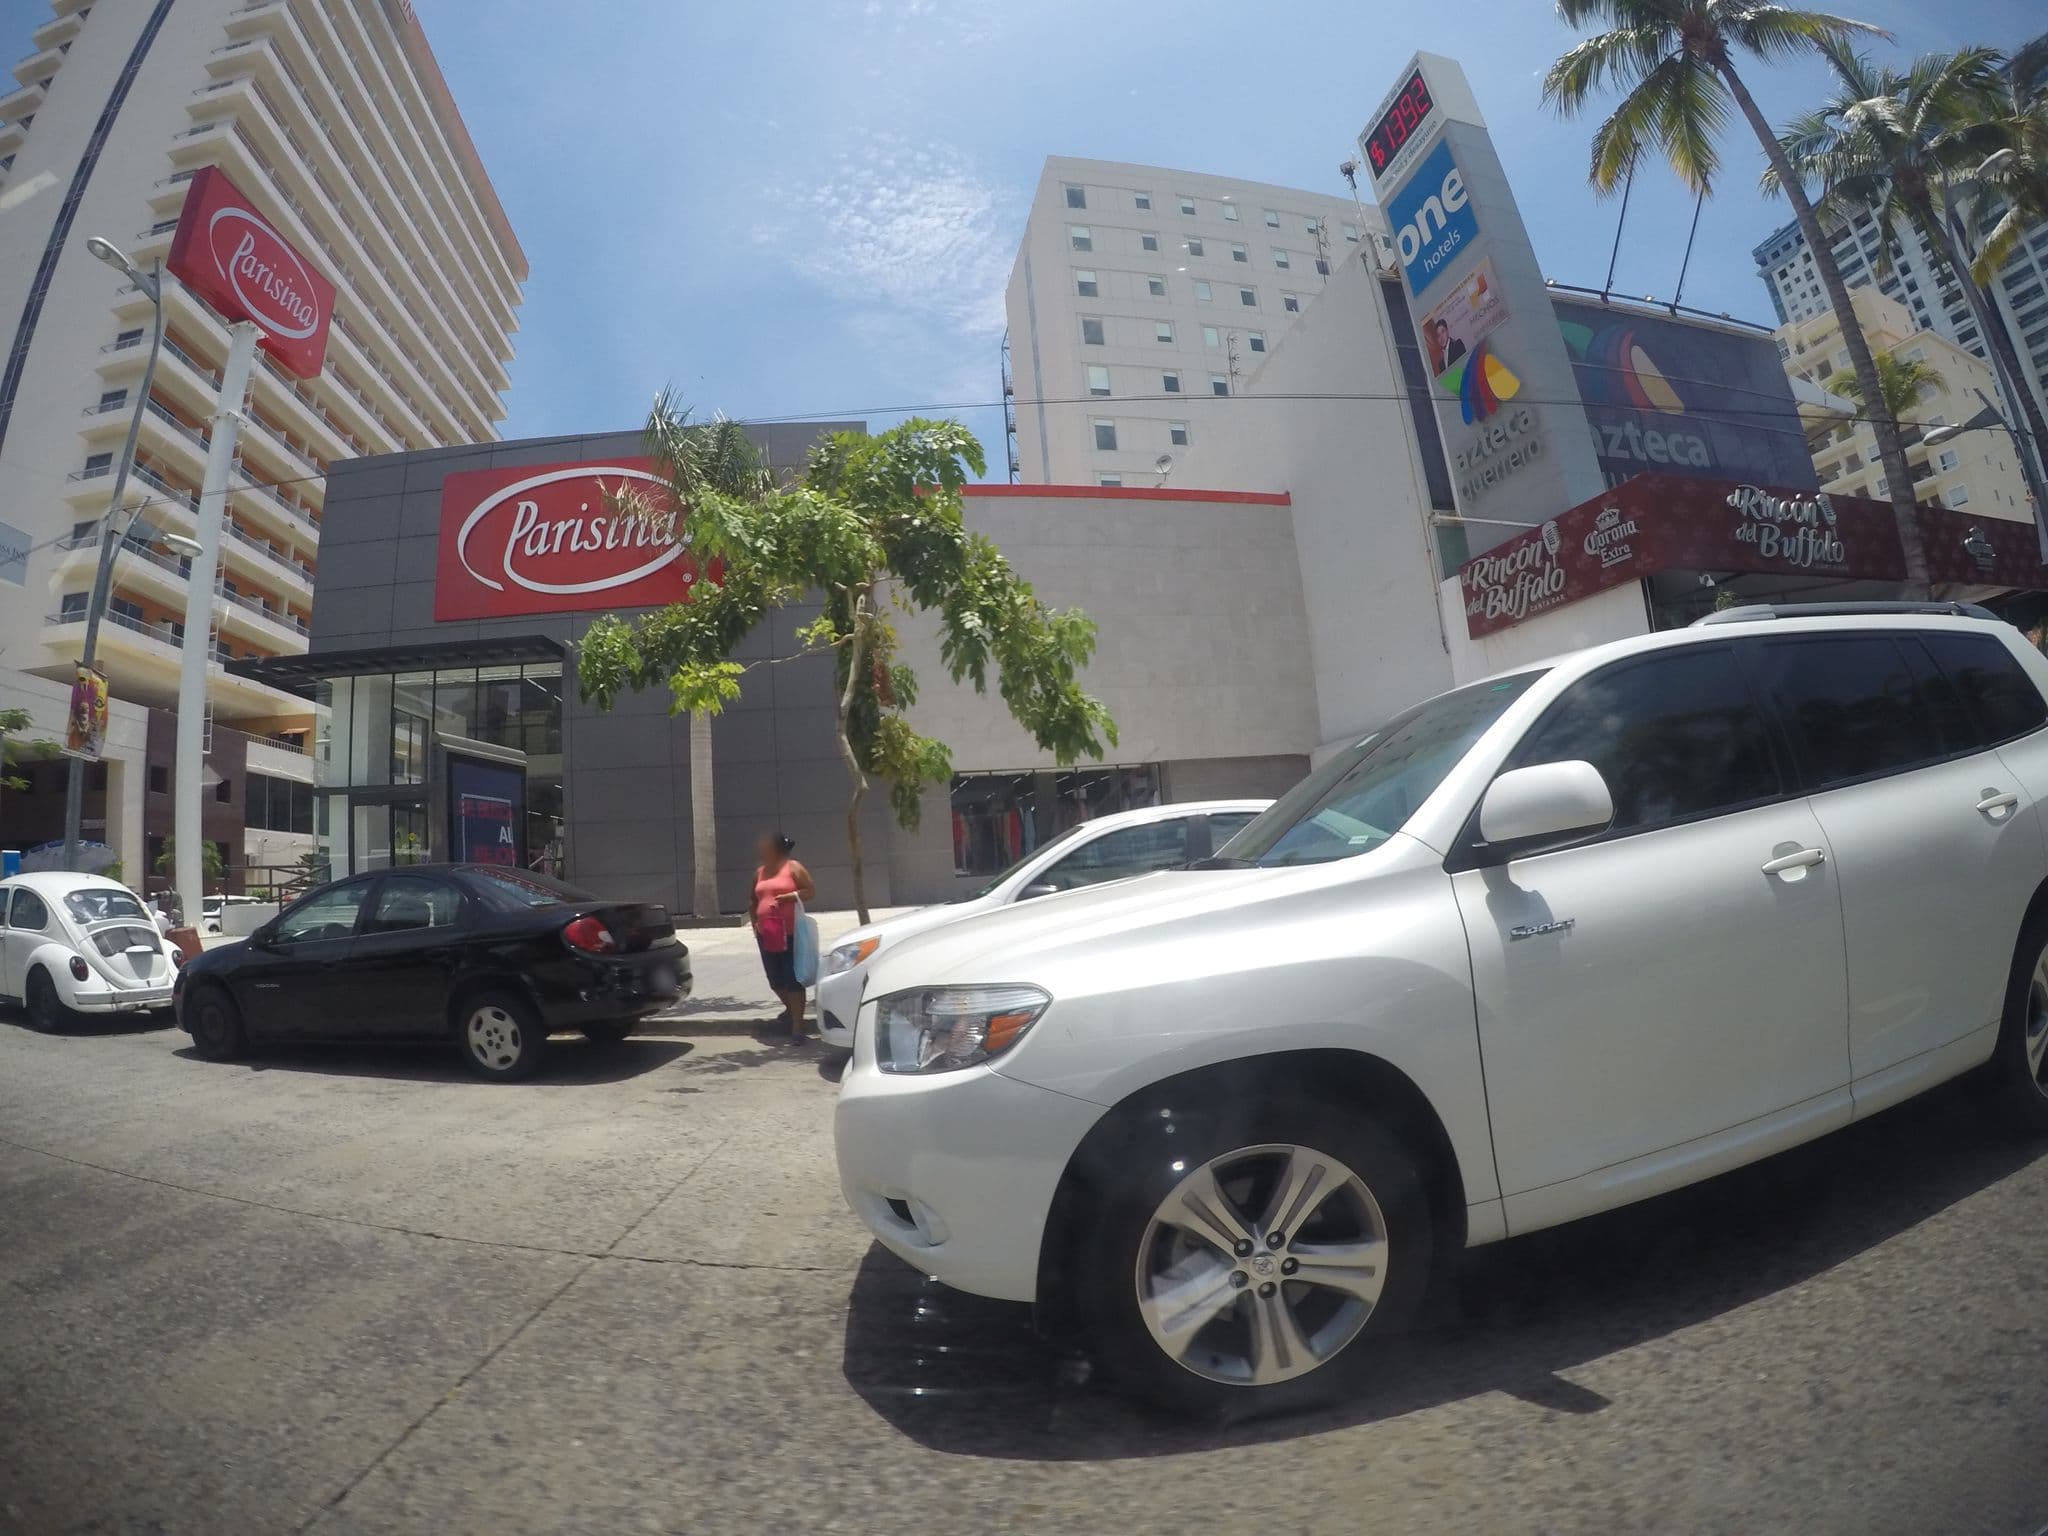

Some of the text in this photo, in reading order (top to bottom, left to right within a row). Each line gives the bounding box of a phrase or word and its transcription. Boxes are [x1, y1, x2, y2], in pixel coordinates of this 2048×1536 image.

[1397, 168, 1469, 267] one
[229, 230, 314, 327] Parisina
[1424, 229, 1461, 273] hotels
[1456, 407, 1532, 472] azteca
[1461, 437, 1540, 502] guerrero
[505, 500, 677, 558] Parisina
[1584, 520, 1640, 555] Corona
[1601, 543, 1632, 561] Extra
[1736, 521, 1845, 567] del Buffalo
[1467, 561, 1566, 619] del Buffalo
[1472, 540, 1545, 591] Rincón
